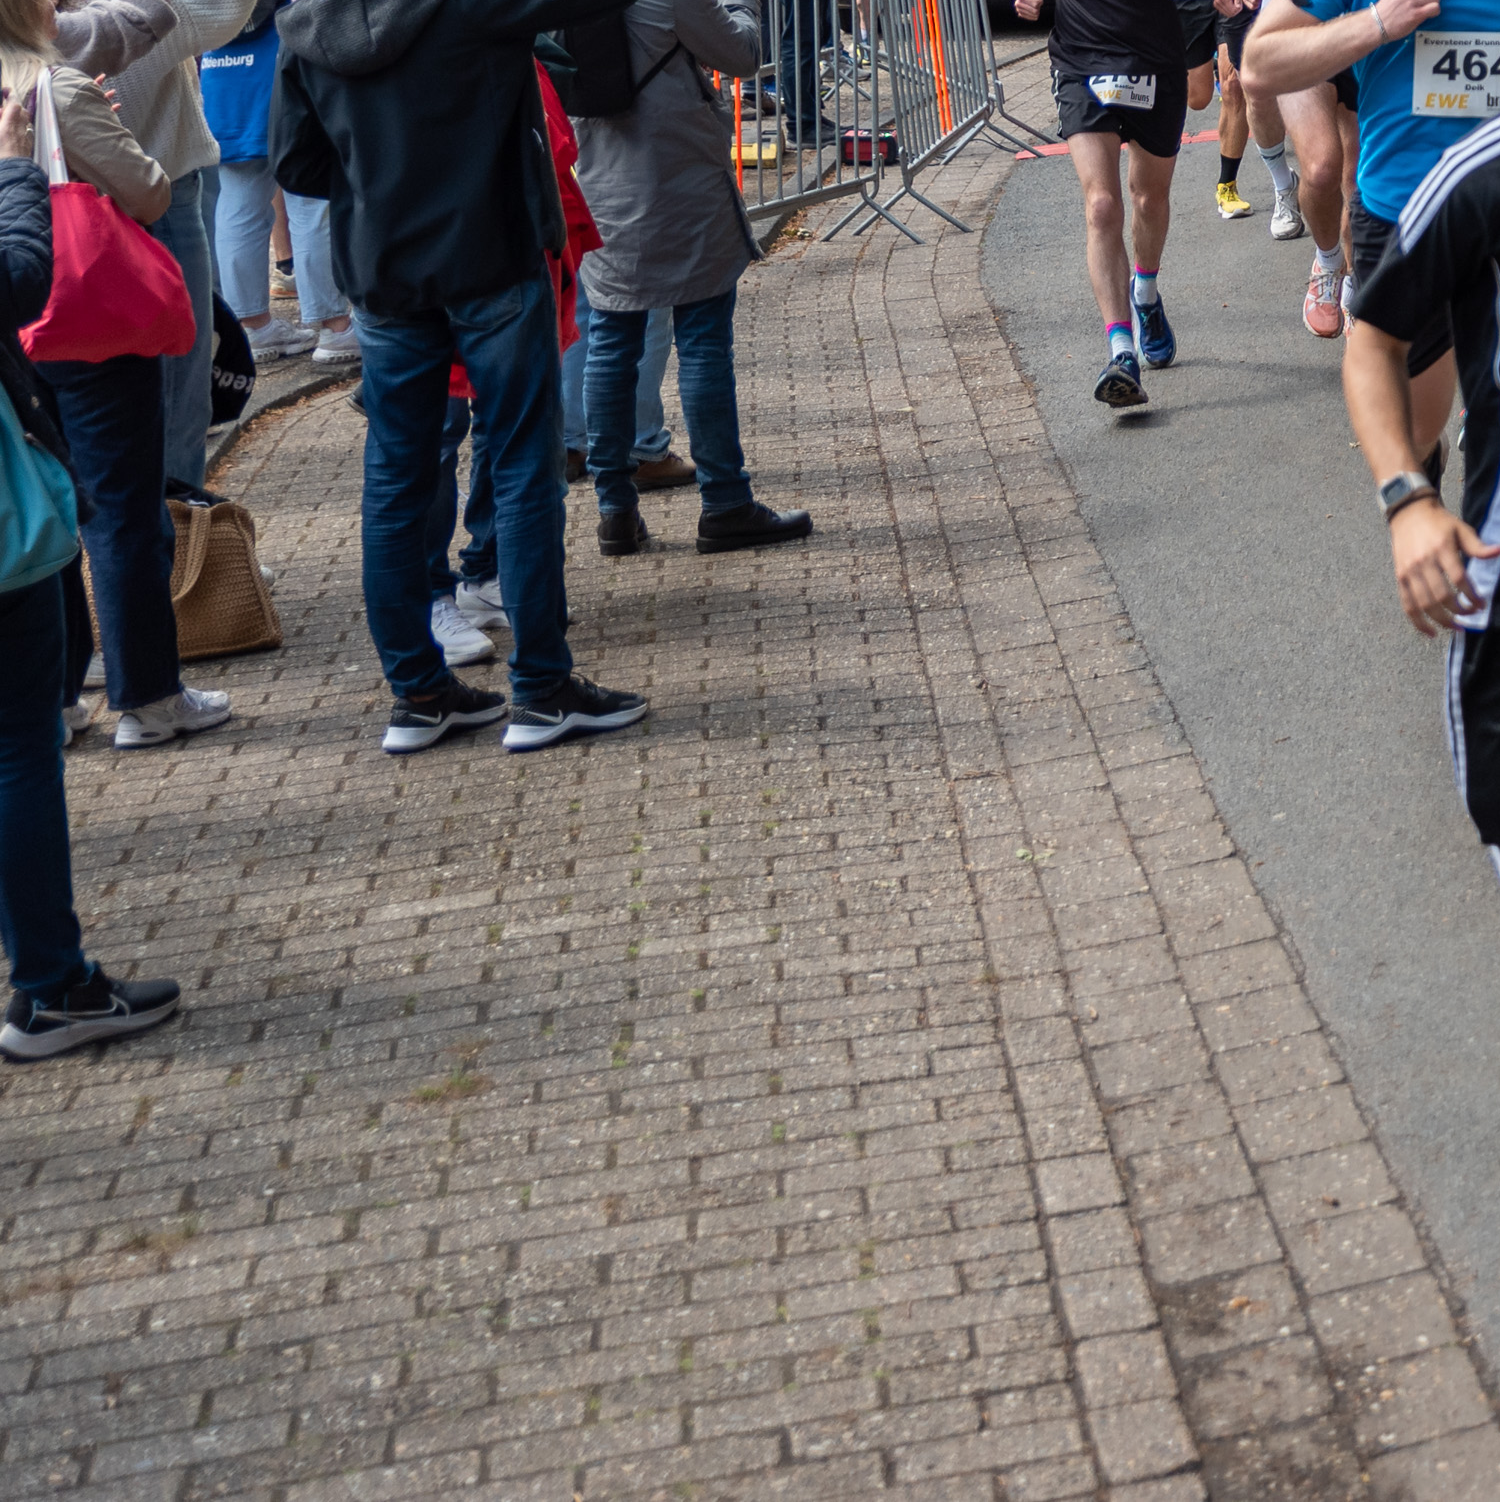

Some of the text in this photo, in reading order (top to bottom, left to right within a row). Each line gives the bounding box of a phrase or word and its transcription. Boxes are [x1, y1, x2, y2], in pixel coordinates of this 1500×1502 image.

[1424, 38, 1472, 46] Everstener
[1130, 91, 1150, 102] bruns
[1425, 92, 1470, 109] EWE
